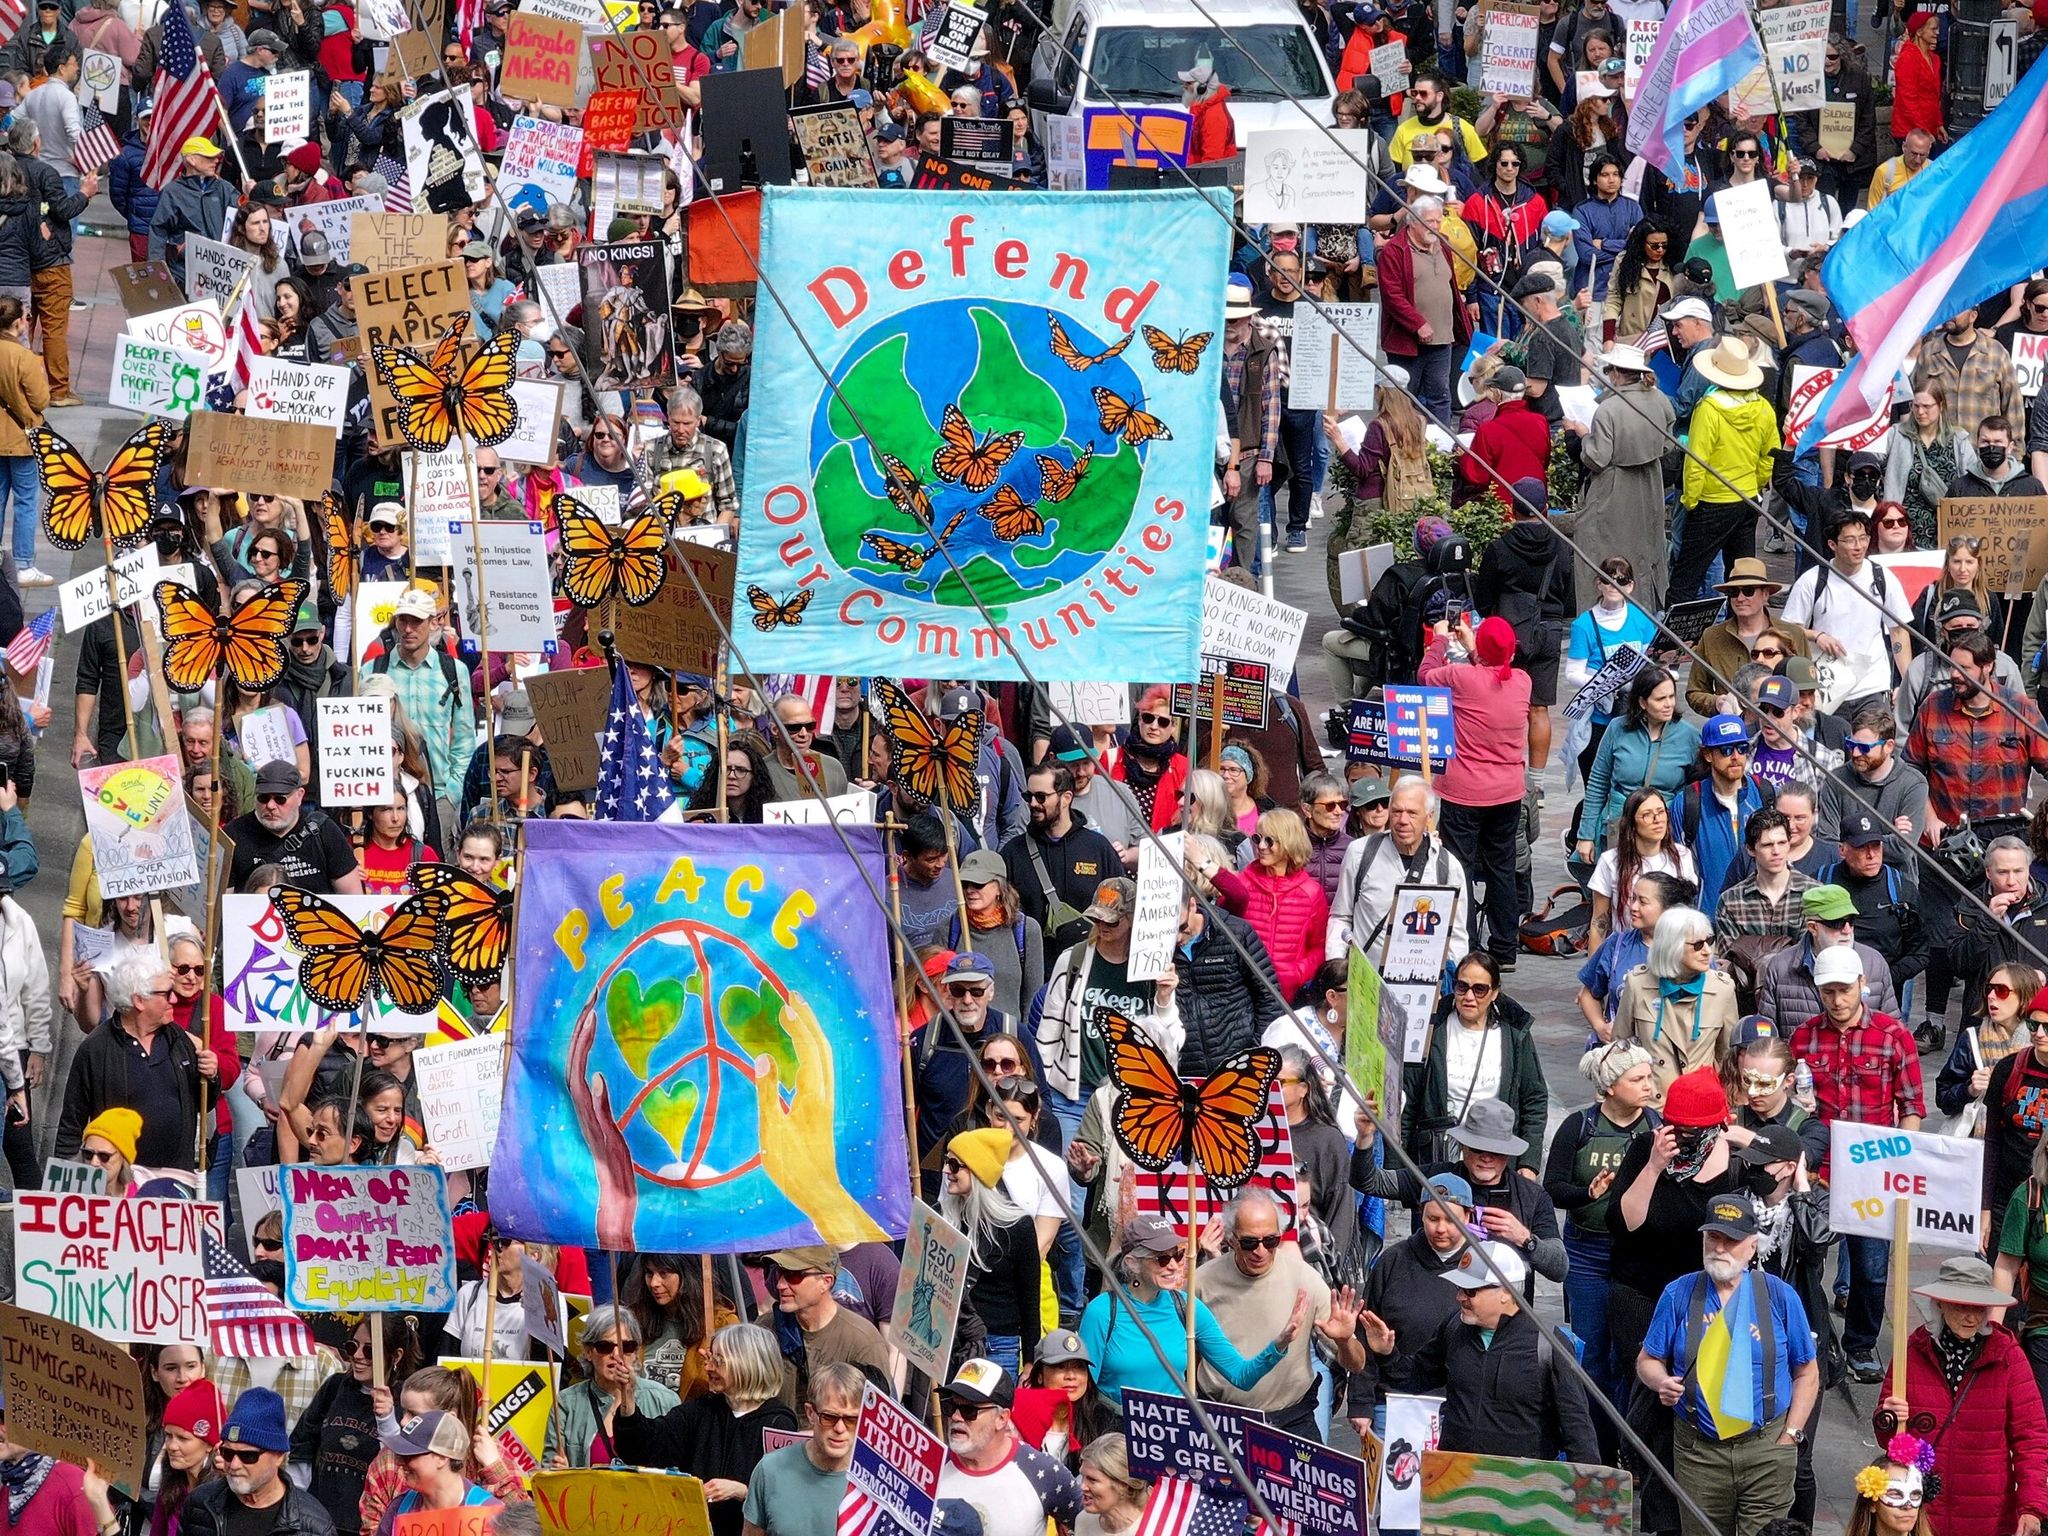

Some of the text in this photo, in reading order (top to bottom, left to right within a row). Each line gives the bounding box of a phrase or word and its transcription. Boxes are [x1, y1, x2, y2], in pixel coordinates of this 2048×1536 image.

[1492, 2, 1522, 13] REAL
[1762, 3, 1829, 23] WIND AND SOLAR
[948, 20, 974, 37] WAR
[949, 11, 979, 28] STOP
[1486, 11, 1539, 29] AMERICANS
[1787, 16, 1826, 33] NEED THE
[938, 35, 970, 54] IRAN!
[948, 30, 967, 43] ON
[605, 35, 657, 62] NO
[1484, 42, 1536, 59] TOLERATE
[505, 55, 572, 86] MIGRA
[1483, 55, 1535, 70] IGNORANT
[597, 62, 671, 91] KING
[273, 89, 298, 99] RICH
[1480, 81, 1532, 96] AGENDAS
[1989, 82, 2012, 99] ONLY
[268, 103, 285, 112] TAX
[590, 96, 637, 111] DEFEND
[268, 113, 304, 125] FUCKING
[515, 117, 535, 129] GOD
[591, 114, 630, 129] BASIC
[952, 120, 966, 130] We
[272, 123, 301, 137] RICH
[527, 129, 556, 148] TRAGIC
[584, 128, 629, 142] SCIENCE
[508, 141, 520, 150] OF
[507, 151, 535, 167] TO MAN
[965, 151, 981, 159] NOT
[982, 151, 1001, 160] OKAY
[503, 162, 530, 178] PASS
[819, 157, 865, 174] AGAINST
[925, 158, 948, 176] NO
[321, 198, 367, 216] TRUMP
[323, 218, 348, 234] IS A
[370, 214, 425, 236] VETO
[379, 237, 415, 256] THE
[588, 245, 655, 262] NO KINGS!
[195, 245, 228, 267] HANDS
[212, 267, 233, 284] OUR
[806, 213, 1161, 334] Defend
[363, 265, 455, 306] ELECT
[402, 301, 425, 320] A
[145, 323, 168, 342] NO
[125, 344, 172, 364] PEOPLE
[122, 360, 157, 377] OVER
[121, 373, 161, 395] PROFIT
[270, 369, 336, 391] HANDS OFF
[290, 389, 317, 402] OUR
[272, 400, 336, 420] DEMOCRACY
[229, 417, 290, 435] PRESIDENT
[239, 432, 268, 446] THUG
[209, 441, 322, 462] GUILTY OF CRIMES
[426, 454, 453, 467] IRAN
[216, 457, 319, 477] AGAINST HUMANITY
[427, 468, 455, 480] COSTS
[1950, 503, 2037, 517] DOES ANYONE
[1947, 517, 2046, 528] HAVE THE NUMBER
[763, 485, 831, 588] Our
[494, 545, 531, 555] Injustice
[512, 558, 533, 568] Law,
[838, 494, 1185, 657] Communities
[75, 581, 94, 599] NO
[489, 589, 538, 600] Resistance
[498, 602, 539, 611] Becomes
[1205, 582, 1303, 630] NO KINGS NO WAR
[520, 614, 541, 625] Duty
[1222, 611, 1296, 646] ICE NO GRIFT
[1217, 628, 1276, 660] BALLROOM
[1385, 689, 1423, 703] Morons
[323, 704, 384, 715] TAX THE
[1397, 706, 1415, 719] Are
[333, 724, 373, 737] RICH
[543, 716, 584, 746] WITH
[1353, 716, 1372, 730] ARE
[325, 746, 385, 756] TAX THE
[1370, 749, 1386, 757] feel
[326, 767, 386, 778] FUCKING
[555, 757, 585, 786] DON
[121, 775, 146, 791] and
[334, 782, 380, 798] RICH
[144, 771, 176, 817] UNITY
[85, 786, 142, 822] LOVE
[136, 862, 165, 874] OVER
[147, 870, 192, 888] DIVISION
[1143, 878, 1180, 893] nothing
[1151, 892, 1171, 901] more
[553, 856, 818, 972] PEACE
[1390, 957, 1436, 966] AMERICA
[1085, 988, 1143, 1011] Keep
[418, 1052, 444, 1067] POLICY
[427, 1080, 455, 1091] CRATIC
[425, 1099, 462, 1117] Whim
[432, 1120, 469, 1143] Graft
[1849, 1135, 1912, 1164] SEND
[1883, 1171, 1927, 1196] ICE
[1851, 1197, 1974, 1235] TO IRAN
[19, 1195, 223, 1265] ICE AGENTS
[61, 1244, 108, 1270] ARE
[296, 1234, 442, 1267] Don't Fear
[928, 1239, 956, 1274] 250
[927, 1260, 955, 1290] YEARS
[305, 1266, 428, 1307] Equality
[22, 1260, 133, 1332] STINKY
[16, 1316, 118, 1370] THEY BLAME
[902, 1332, 936, 1363] 1776-2026
[3, 1335, 134, 1411] IMMIGRANTS
[10, 1372, 138, 1439] SO YOU BLAME
[1129, 1400, 1190, 1426] HATE
[876, 1401, 931, 1459] STOP
[1130, 1421, 1180, 1444] NOT
[499, 1430, 535, 1473] NOW
[863, 1417, 935, 1491] TRUMP
[1132, 1441, 1164, 1461] US
[1252, 1445, 1357, 1499] NO KINGS
[877, 1463, 910, 1500] SAVE
[1299, 1481, 1312, 1496] IN
[852, 1460, 928, 1533] DEMOCRACY
[1256, 1479, 1358, 1532] AMERICA
[1282, 1508, 1332, 1534] SINCE 1776
